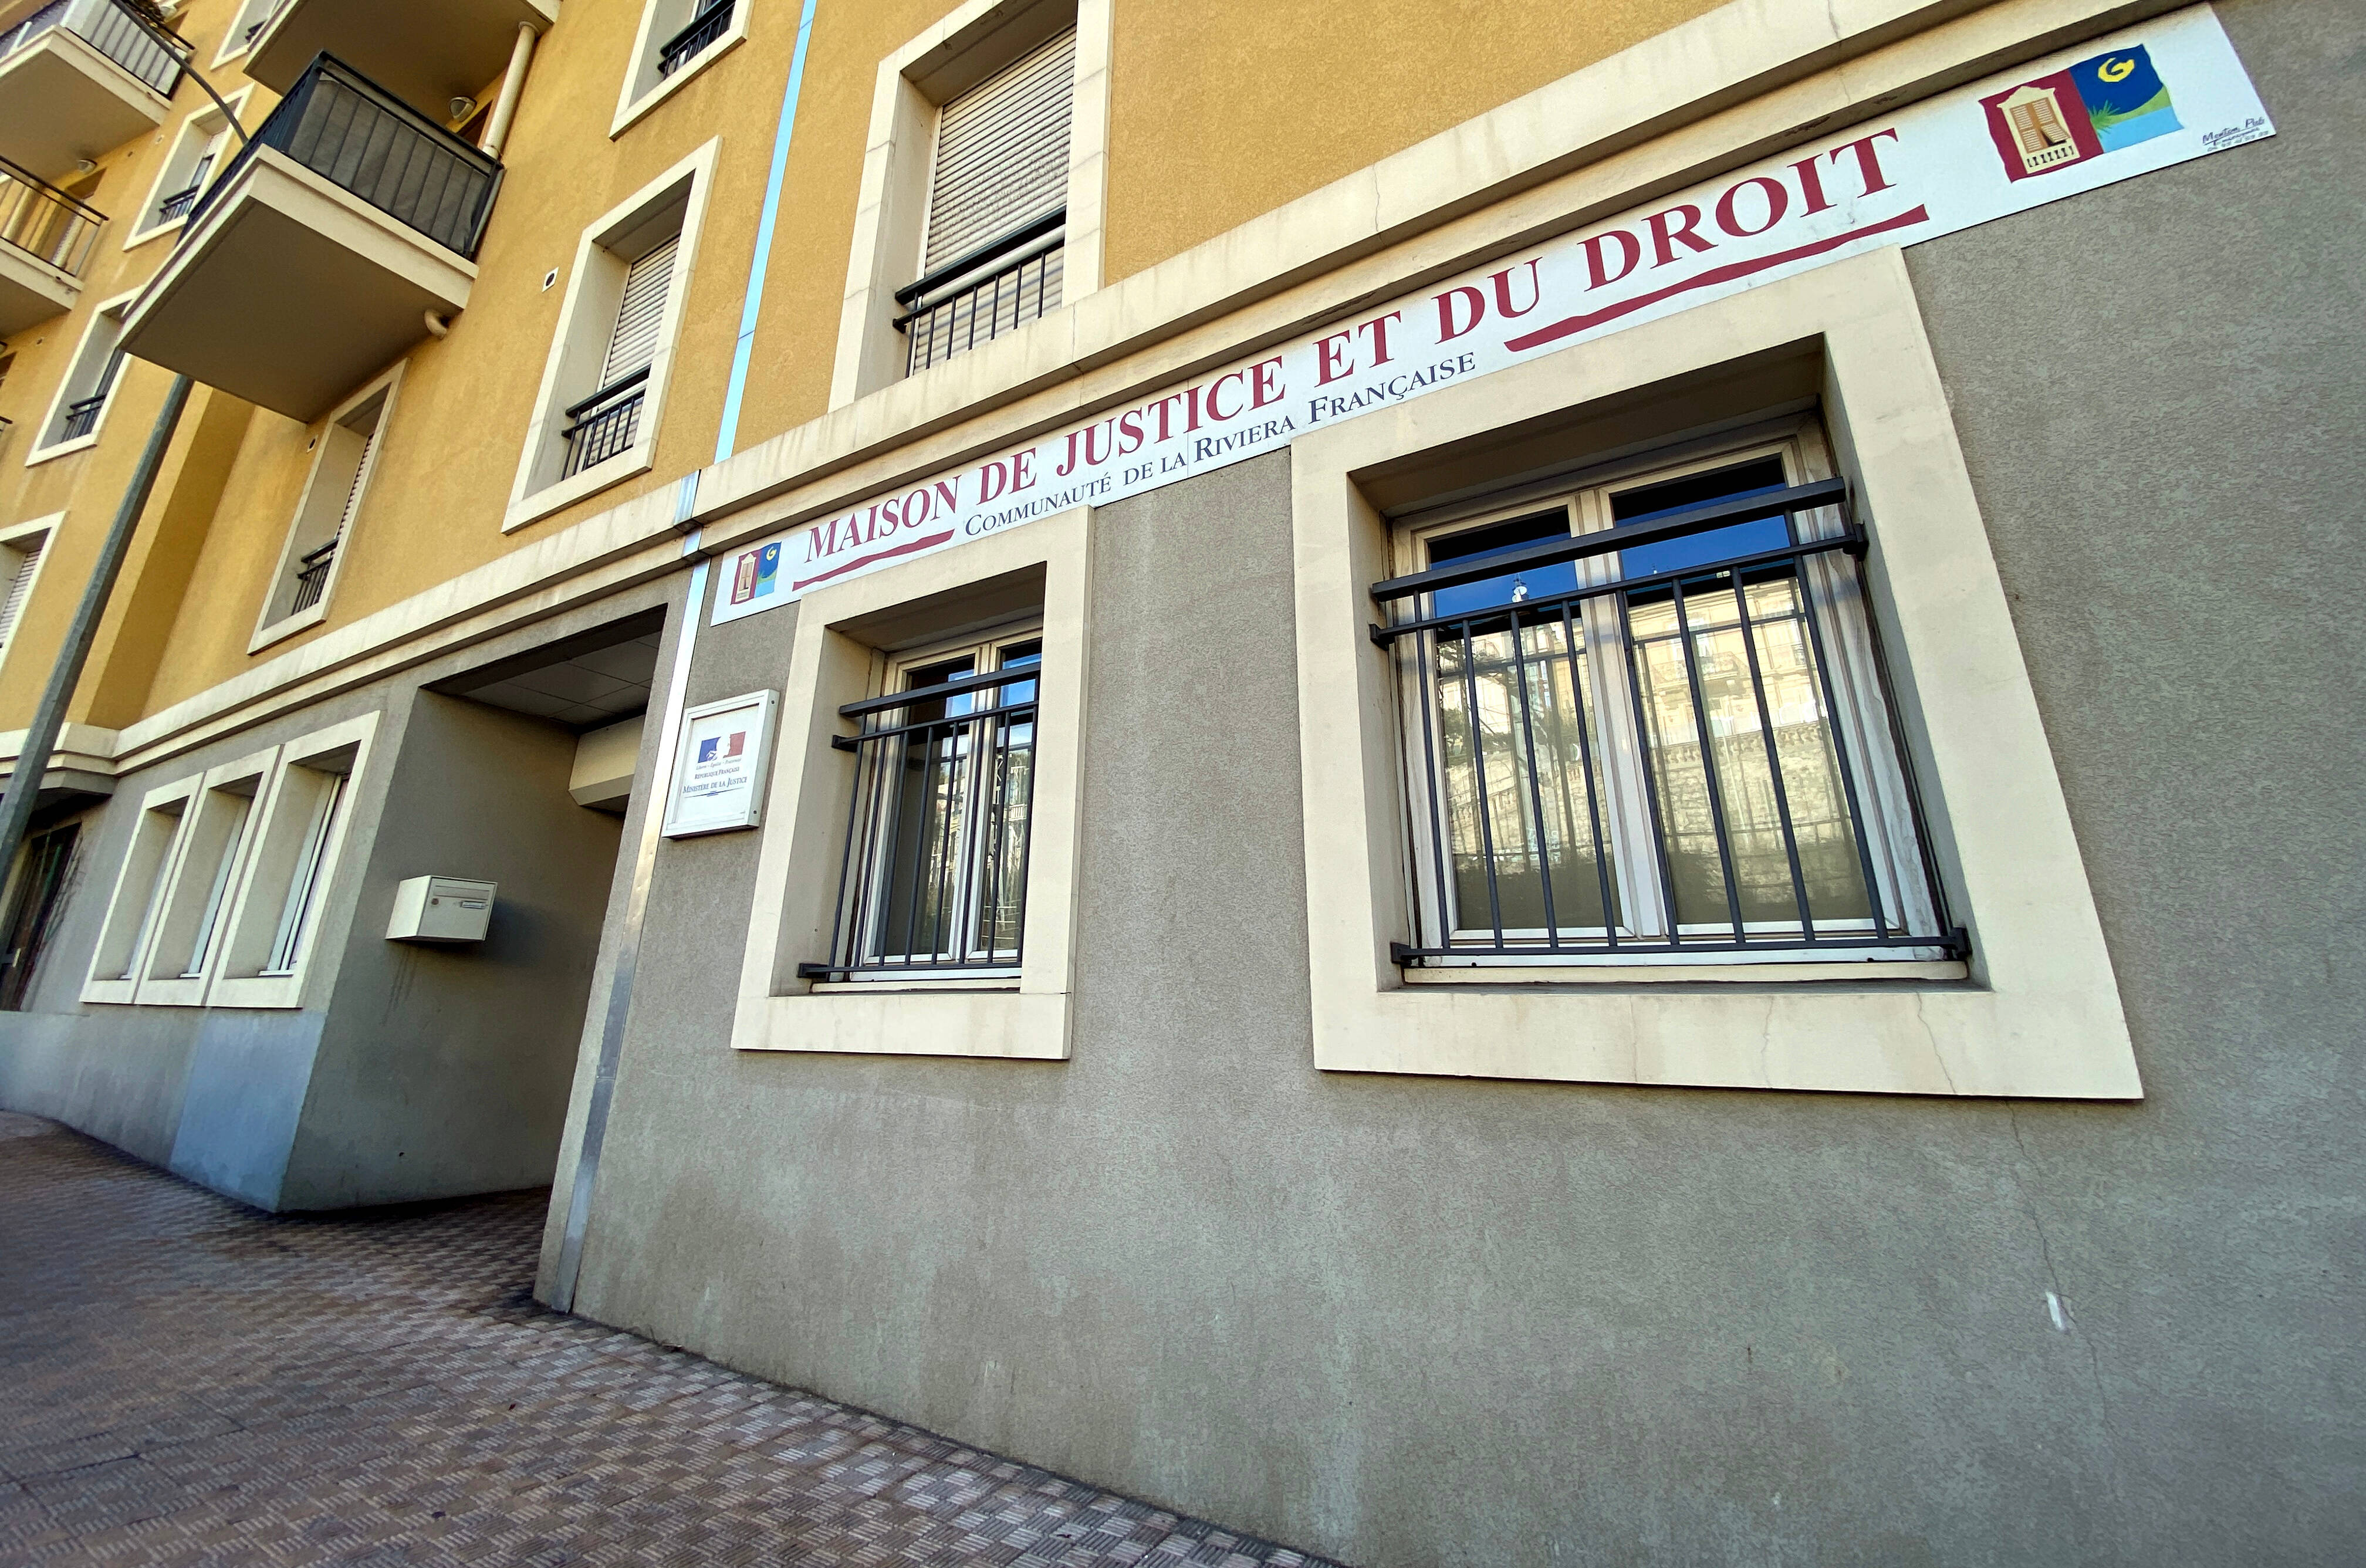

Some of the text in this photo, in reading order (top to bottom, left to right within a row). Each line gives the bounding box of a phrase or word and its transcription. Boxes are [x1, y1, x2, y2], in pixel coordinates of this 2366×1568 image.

[805, 127, 1899, 563] MAISON DE JUSTICE ET DU DROIT
[965, 352, 1476, 536] COMMUNAUTÉ DE LA RIVIERA FRANÇAISE
[726, 776, 748, 788] JUSTICE
